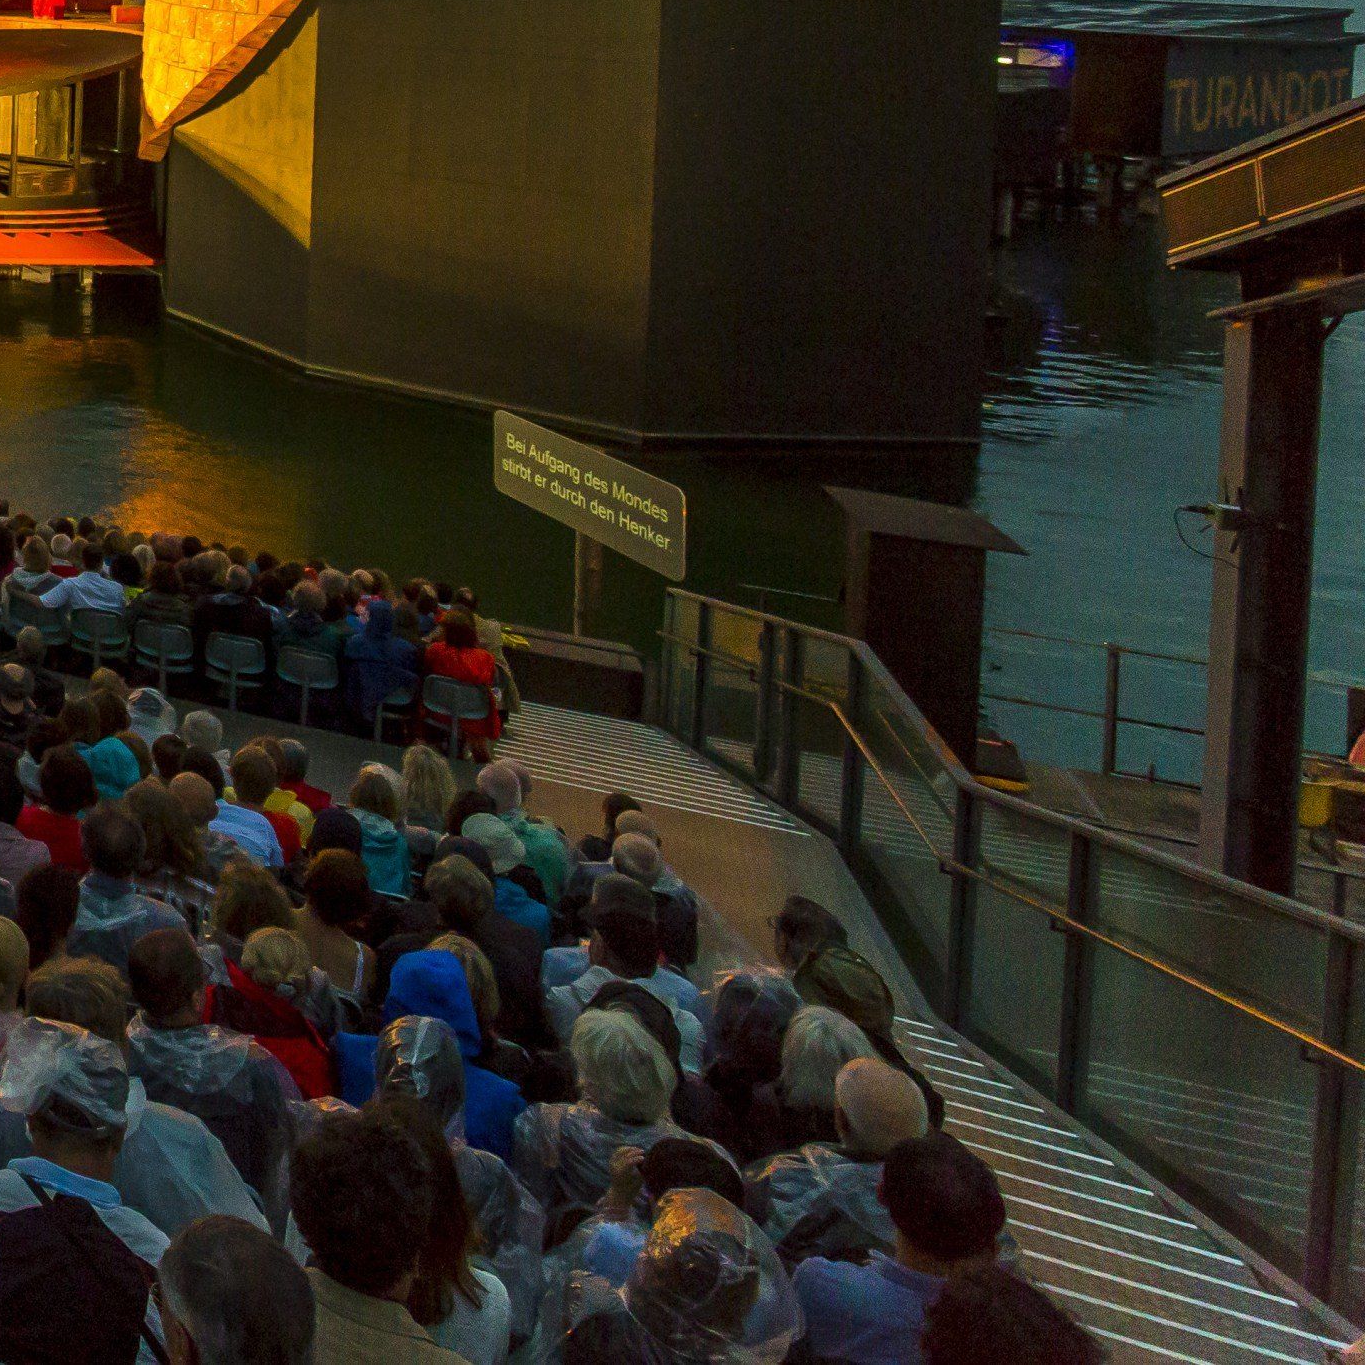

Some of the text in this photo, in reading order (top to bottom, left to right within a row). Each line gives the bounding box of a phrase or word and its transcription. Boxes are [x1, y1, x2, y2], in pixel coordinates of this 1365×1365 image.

[1167, 67, 1349, 136] TURANDOT
[502, 458, 531, 482] stirbt
[534, 474, 546, 488] er
[550, 480, 586, 509] durch
[590, 500, 615, 524] den
[506, 432, 668, 523] Bei Aufgang des Mondes
